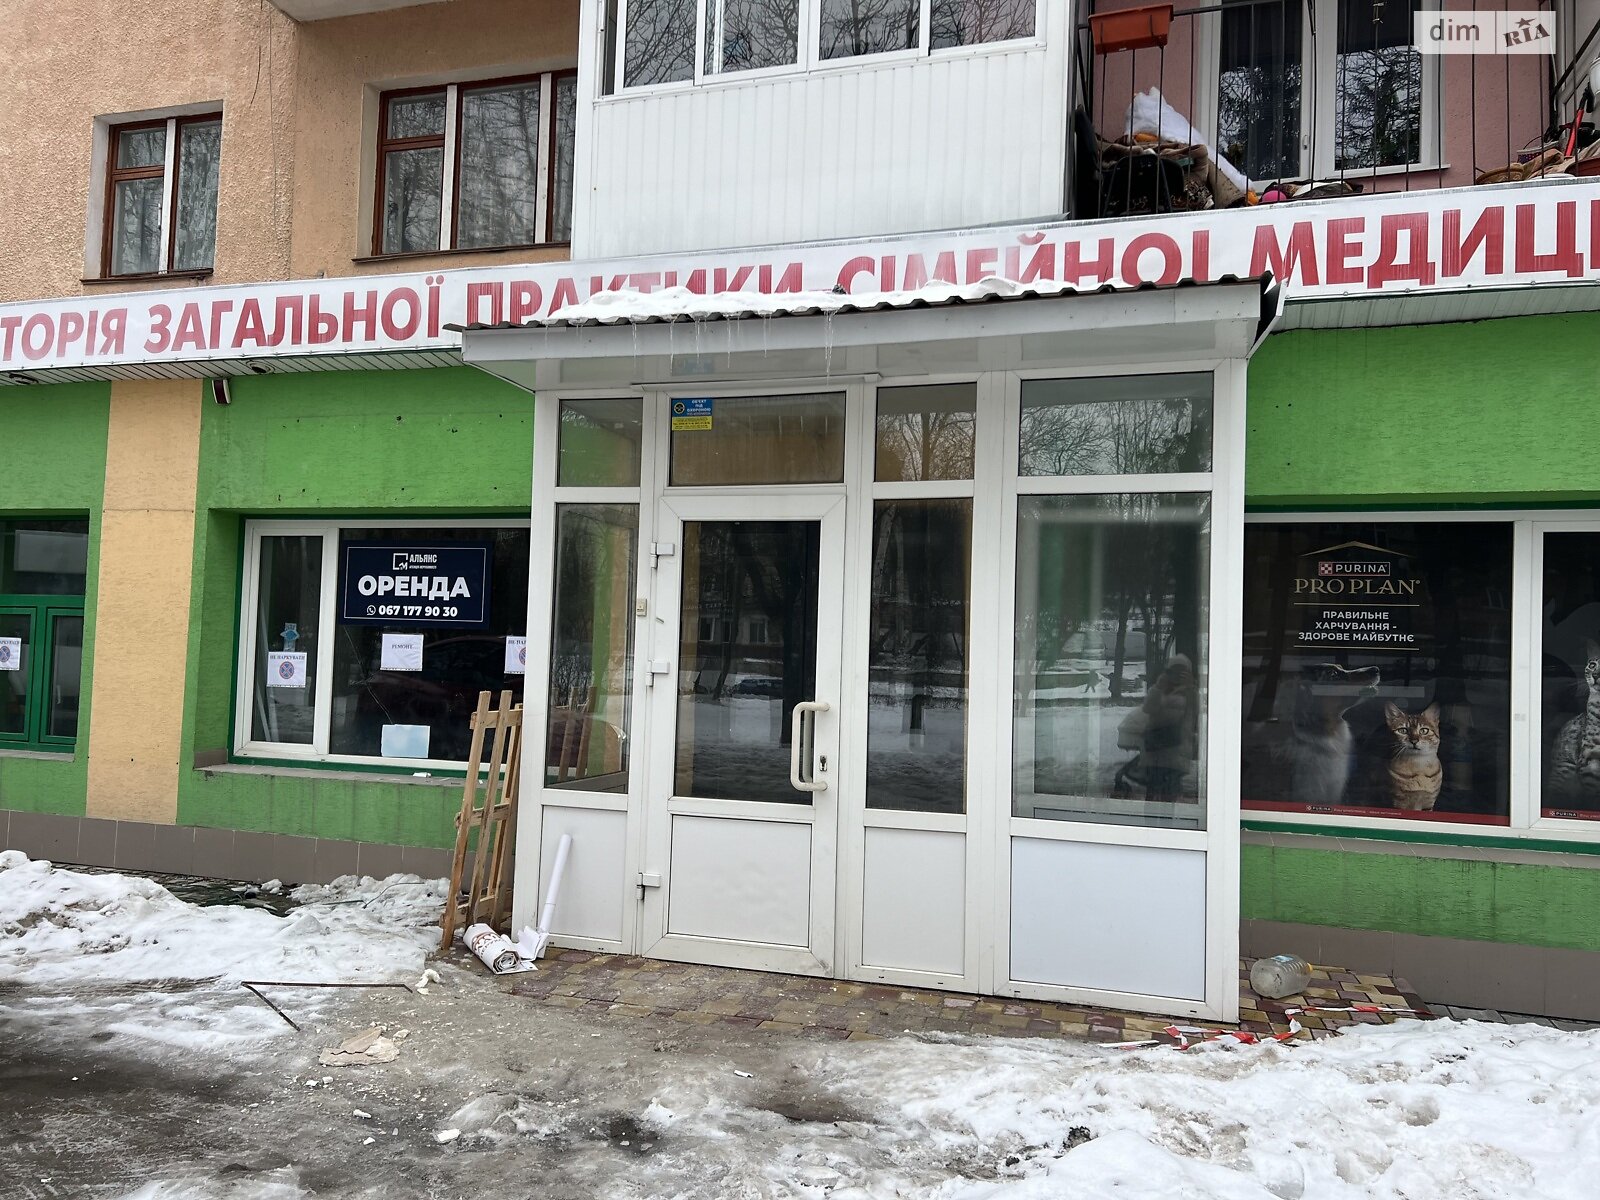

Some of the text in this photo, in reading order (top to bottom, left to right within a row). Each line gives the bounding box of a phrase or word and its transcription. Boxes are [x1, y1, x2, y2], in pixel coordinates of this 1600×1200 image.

[1, 308, 128, 362] ТОРІЯ
[144, 276, 443, 354] ЗАГАЛЬНОЇ
[1250, 199, 1600, 288] МЕДИЦ
[409, 554, 437, 563] АЛЬЯНС
[1335, 564, 1387, 573] PURINA
[358, 575, 471, 601] ОРЕНДА
[1294, 578, 1344, 593] PRO
[378, 605, 458, 617] 067 177 90 30
[1323, 611, 1389, 620] ПРАВИЛЬНЕ
[1315, 621, 1390, 631] ХАРЧУВАННЯ
[1298, 631, 1414, 642] ЗДОРОВЕ МАЙБУТНЄ
